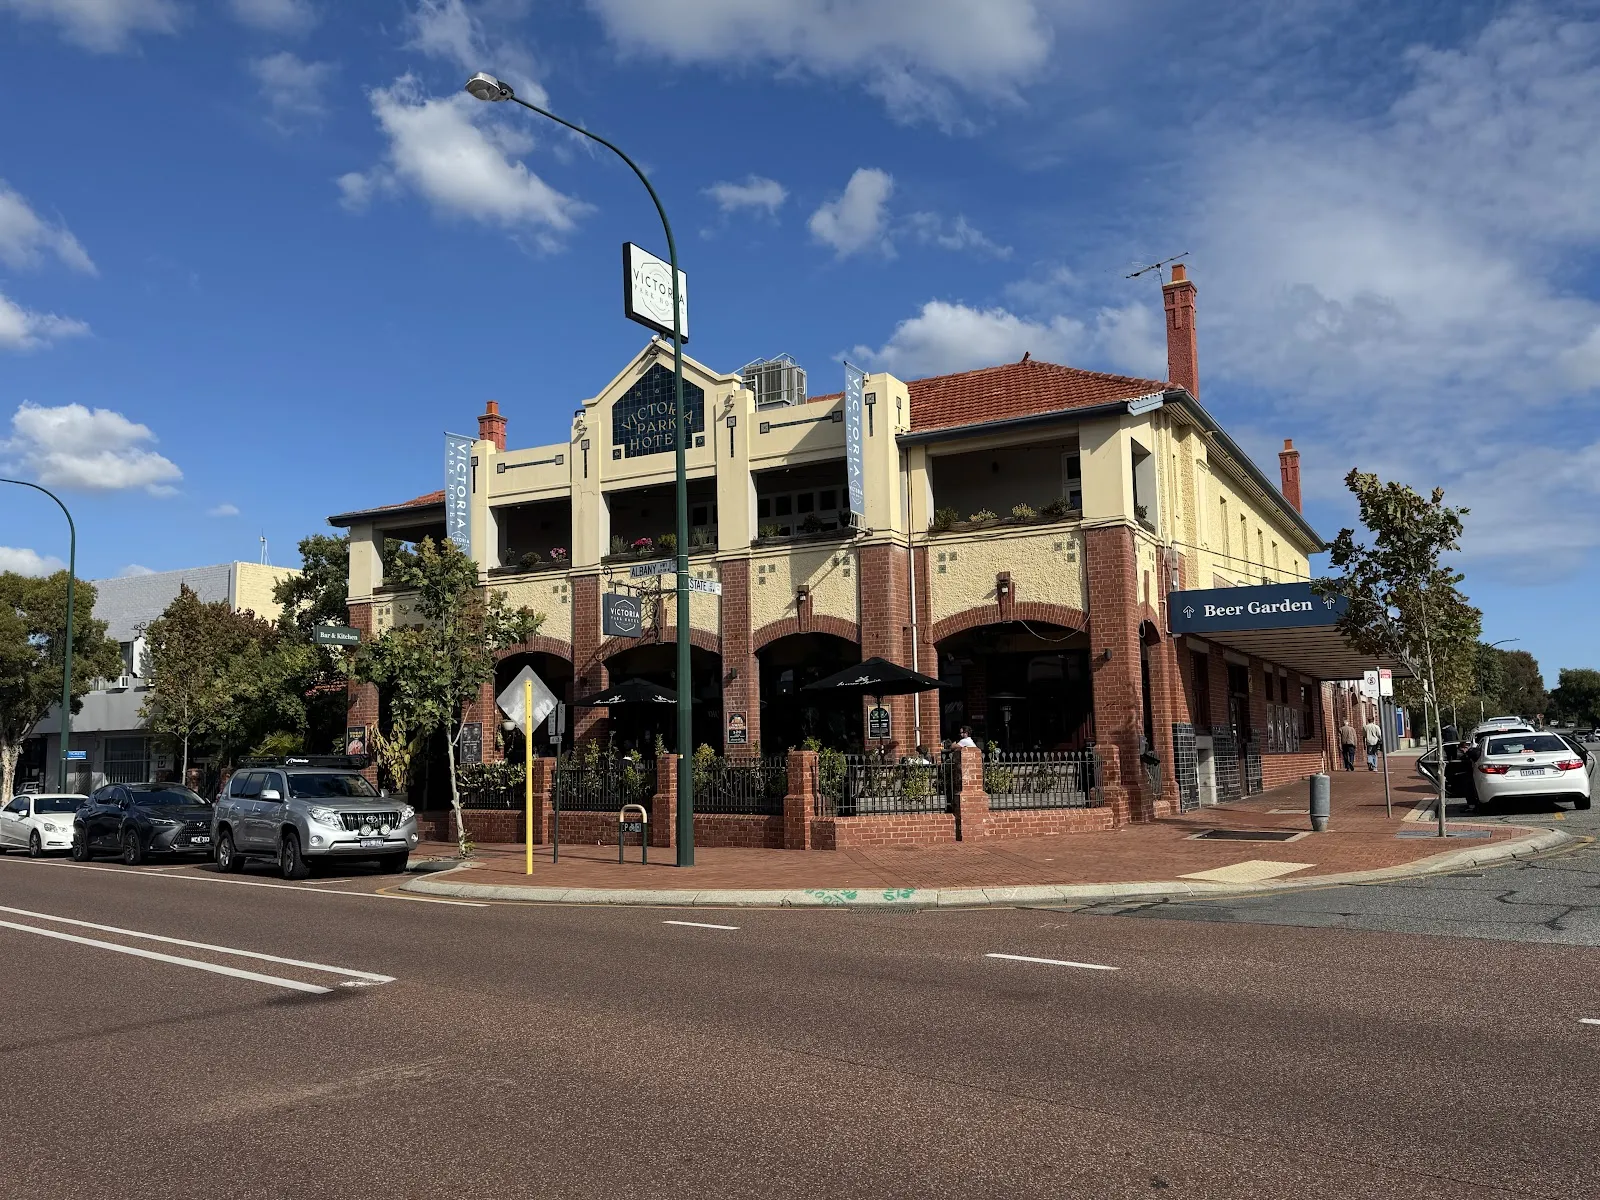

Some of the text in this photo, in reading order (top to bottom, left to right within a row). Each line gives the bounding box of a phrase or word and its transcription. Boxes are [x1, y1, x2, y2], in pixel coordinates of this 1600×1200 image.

[633, 268, 685, 305] VICTORA
[621, 401, 693, 430] VICTORA
[637, 417, 677, 434] PARK
[852, 377, 860, 477] VICTORIA
[630, 432, 674, 451] HOTE
[456, 443, 467, 528] VICTORIA
[448, 484, 456, 526] HOTEL
[631, 563, 657, 577] ALBANY
[690, 579, 707, 592] STATE
[610, 607, 640, 619] VICTORIA
[1204, 599, 1314, 617] Beer Garden
[337, 632, 358, 640] Kitchen
